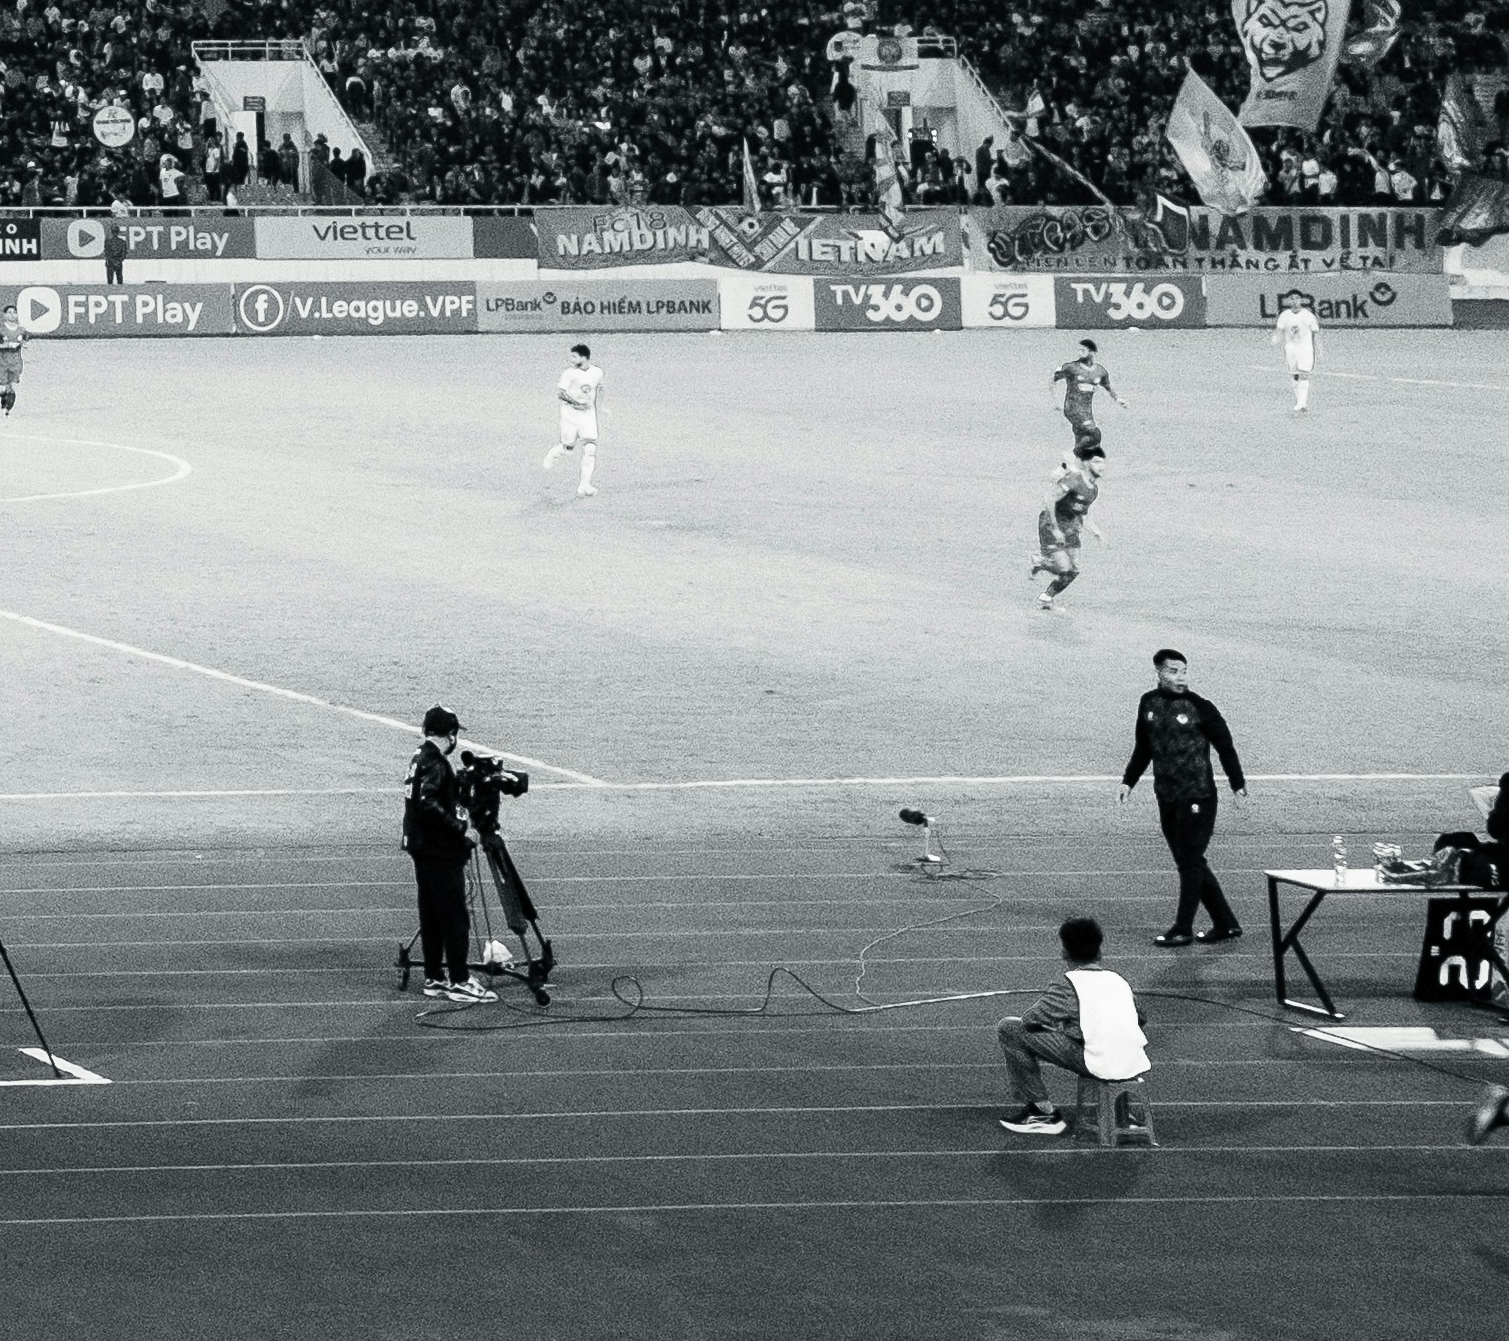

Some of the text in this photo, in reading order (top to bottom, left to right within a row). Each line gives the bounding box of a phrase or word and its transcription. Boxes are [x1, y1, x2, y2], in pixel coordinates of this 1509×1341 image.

[170, 225, 229, 256] Play
[313, 221, 417, 243] viettel
[68, 294, 203, 330] FPT Play
[485, 298, 543, 312] LPBank
[646, 299, 713, 314] LPBANK
[746, 294, 789, 323] 5G
[829, 283, 943, 321] TV360
[988, 293, 1029, 321] 5G
[1071, 282, 1184, 319] TV360
